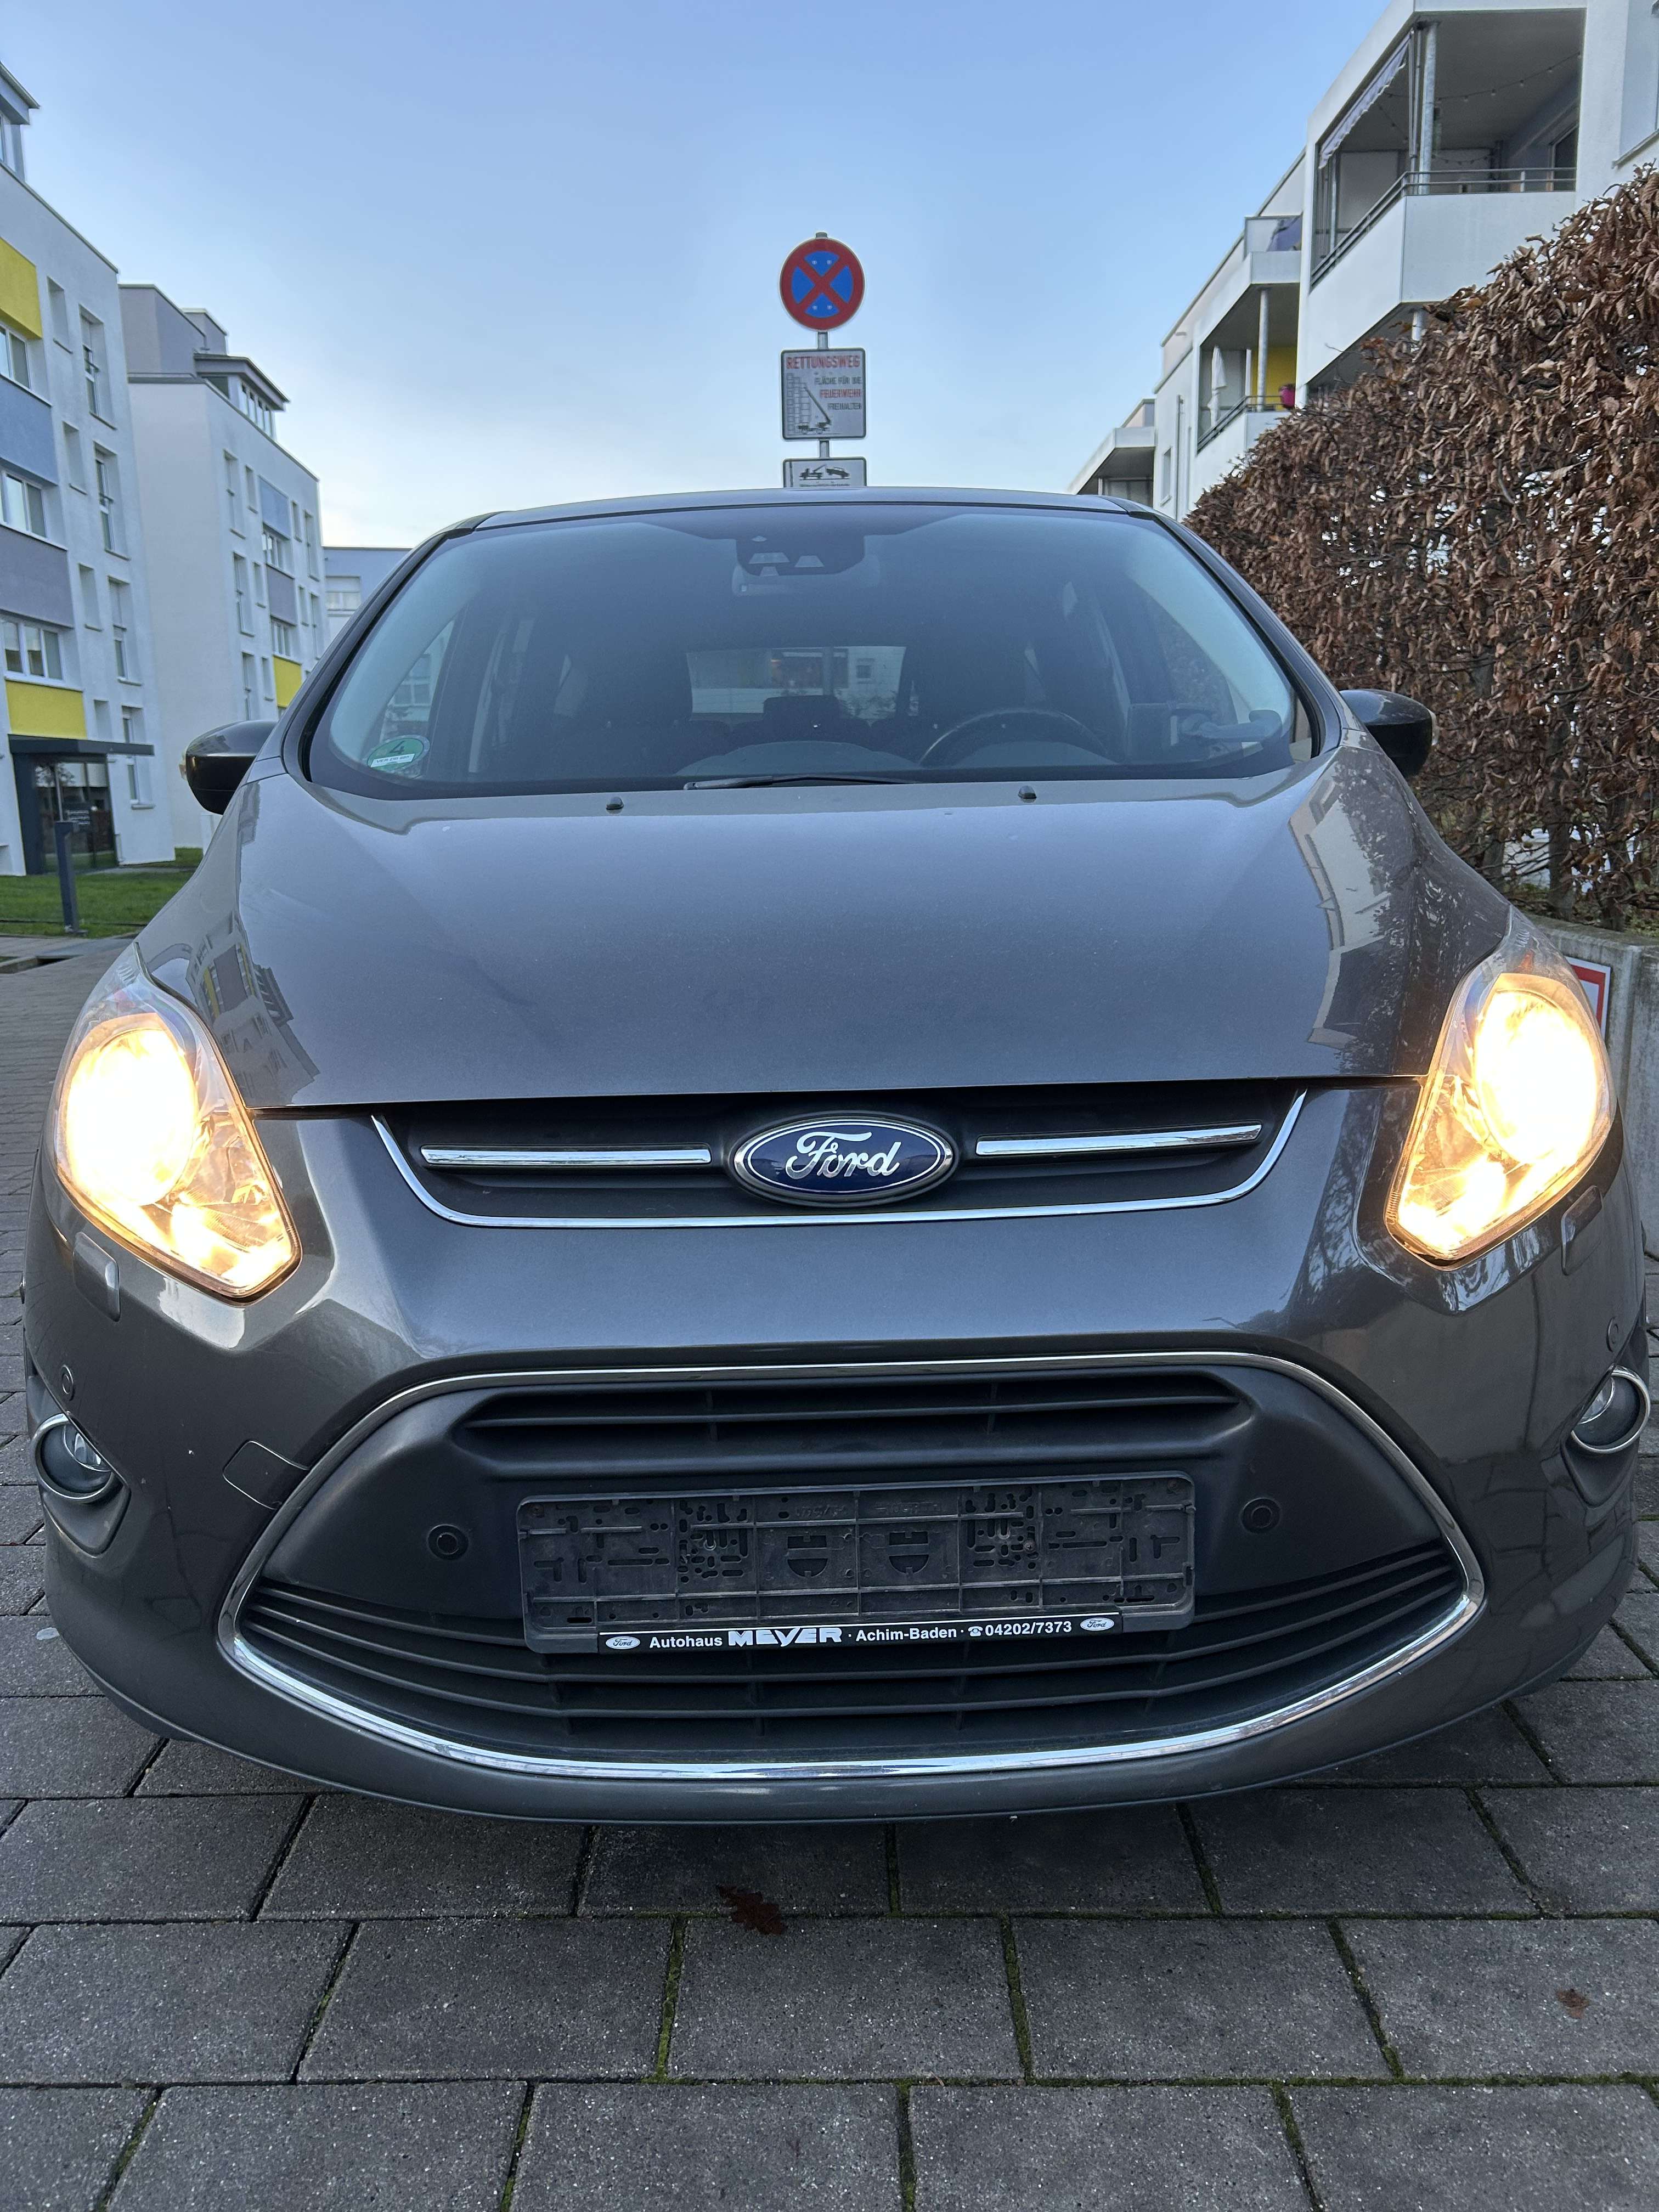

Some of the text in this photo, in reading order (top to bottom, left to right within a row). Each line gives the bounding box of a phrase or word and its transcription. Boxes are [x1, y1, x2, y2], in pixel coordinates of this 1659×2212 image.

[786, 356, 860, 369] RETTUNGSWEG
[815, 376, 837, 385] FLÄCHE
[838, 375, 850, 384] FÜR
[820, 389, 861, 398] FEUERWEHR
[828, 402, 861, 410] FREIHALTEN
[390, 741, 405, 754] 4
[785, 1131, 901, 1180] Ford
[649, 1635, 723, 1648] Autohaus
[728, 1627, 842, 1647] MEYER
[856, 1626, 957, 1642] Achim-Baden
[985, 1621, 1072, 1637] 04202/7373
